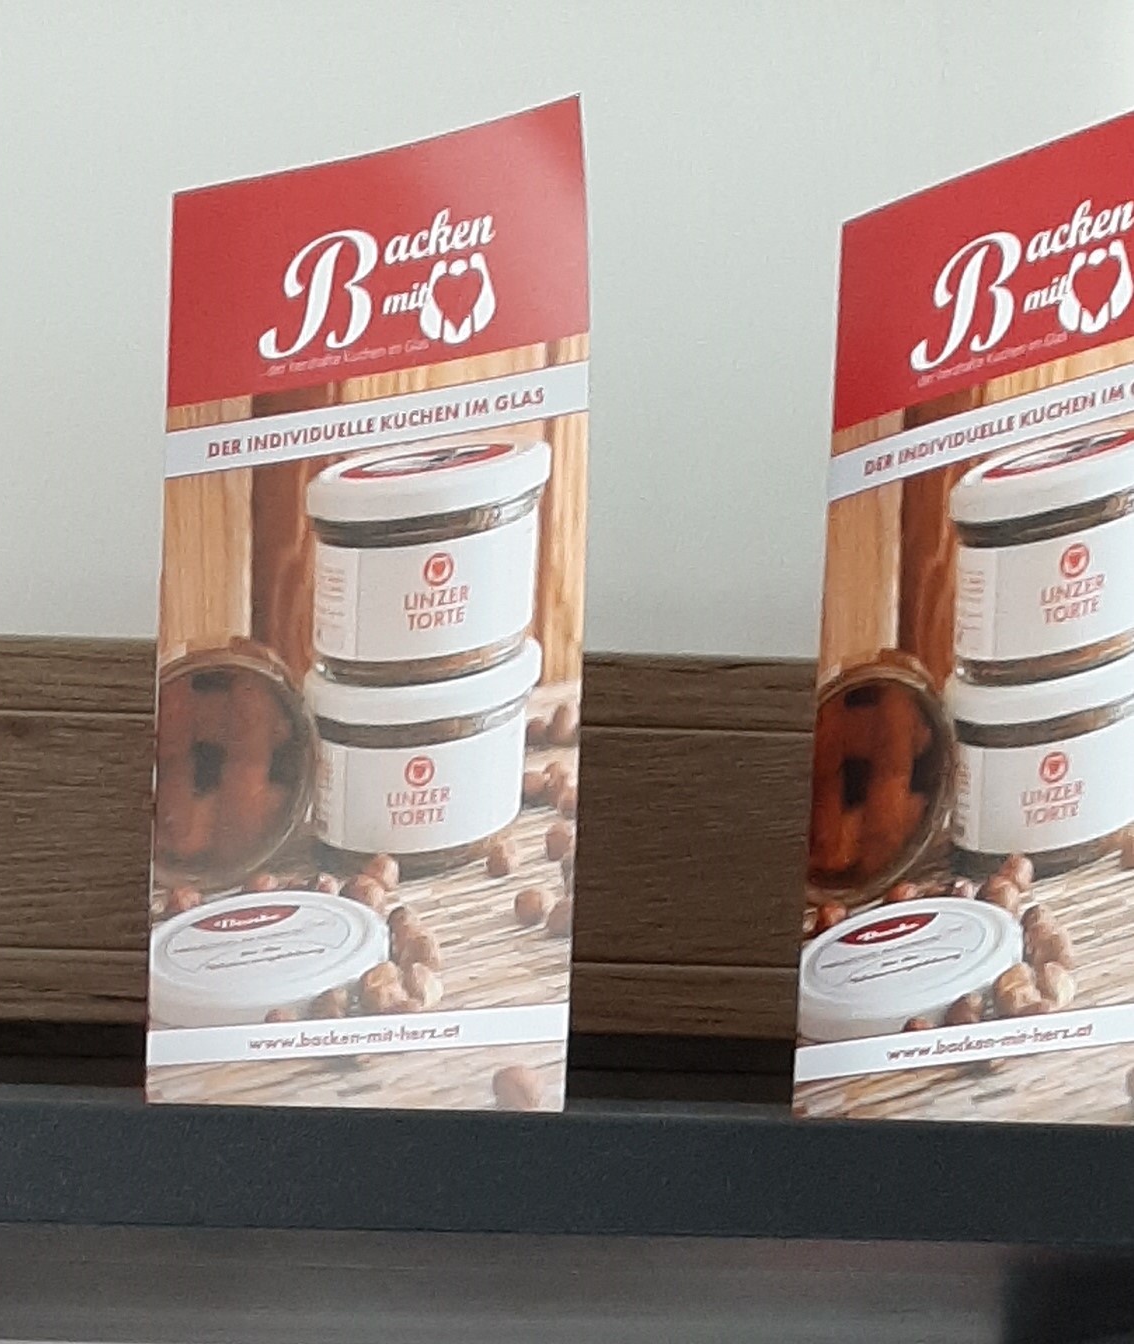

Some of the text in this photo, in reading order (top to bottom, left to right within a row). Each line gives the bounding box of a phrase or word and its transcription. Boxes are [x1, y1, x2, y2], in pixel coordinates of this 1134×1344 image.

[258, 207, 496, 359] Backen
[1023, 274, 1069, 313] mit
[382, 282, 430, 315] mit
[208, 387, 545, 459] DER INDIVIDUELLE KUCHEN IM GLAS
[864, 384, 1125, 476] DER INDIVIDUELLE KUCHEN IM
[404, 584, 469, 611] LINZER
[407, 605, 465, 631] TORTE
[386, 785, 451, 808] LINZER
[389, 807, 445, 828] TORTE
[249, 1023, 461, 1050] www.backen-mit-herz.at
